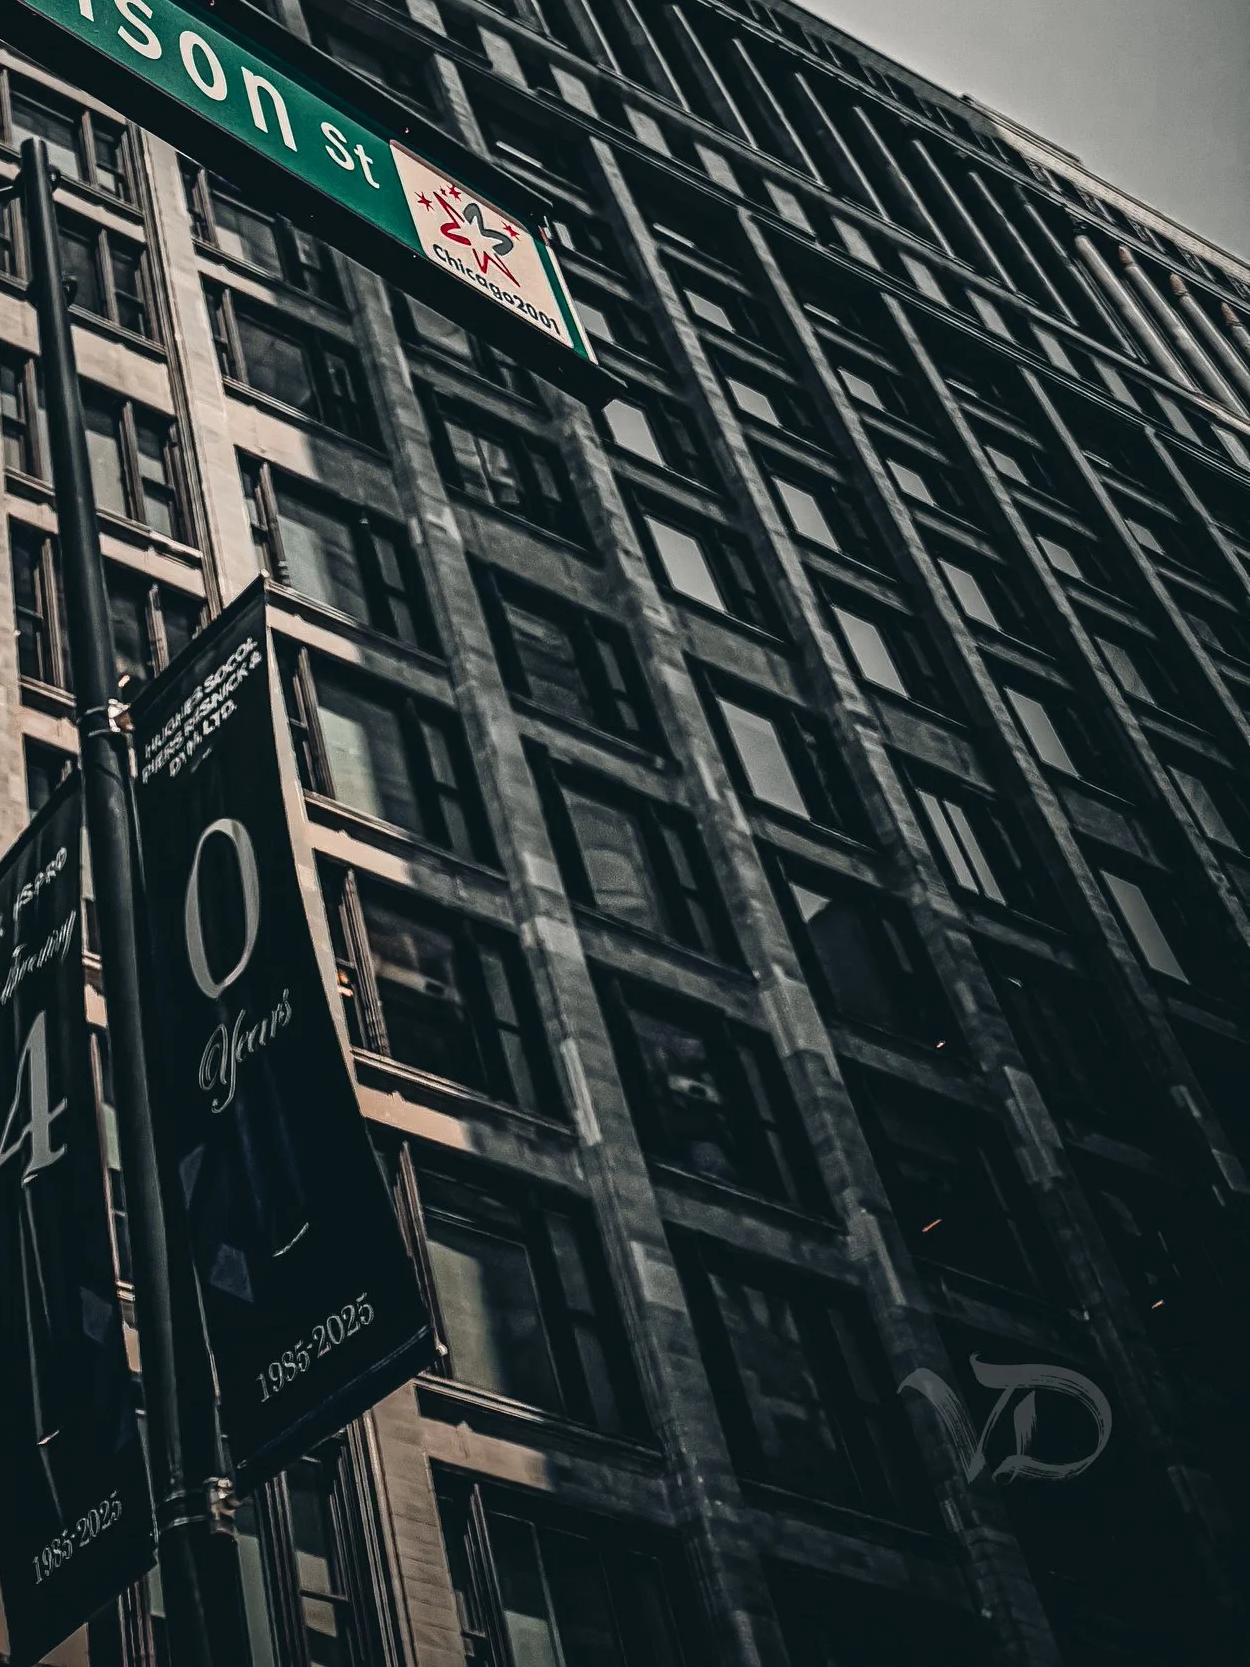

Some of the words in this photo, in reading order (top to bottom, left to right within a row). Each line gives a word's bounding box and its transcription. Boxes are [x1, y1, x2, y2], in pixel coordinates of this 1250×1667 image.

[321, 118, 381, 191] St
[433, 243, 561, 336] Chicago2001
[184, 817, 261, 1000] 0
[255, 1291, 376, 1405] 1985-2025
[31, 1490, 123, 1586] 1985-2025
